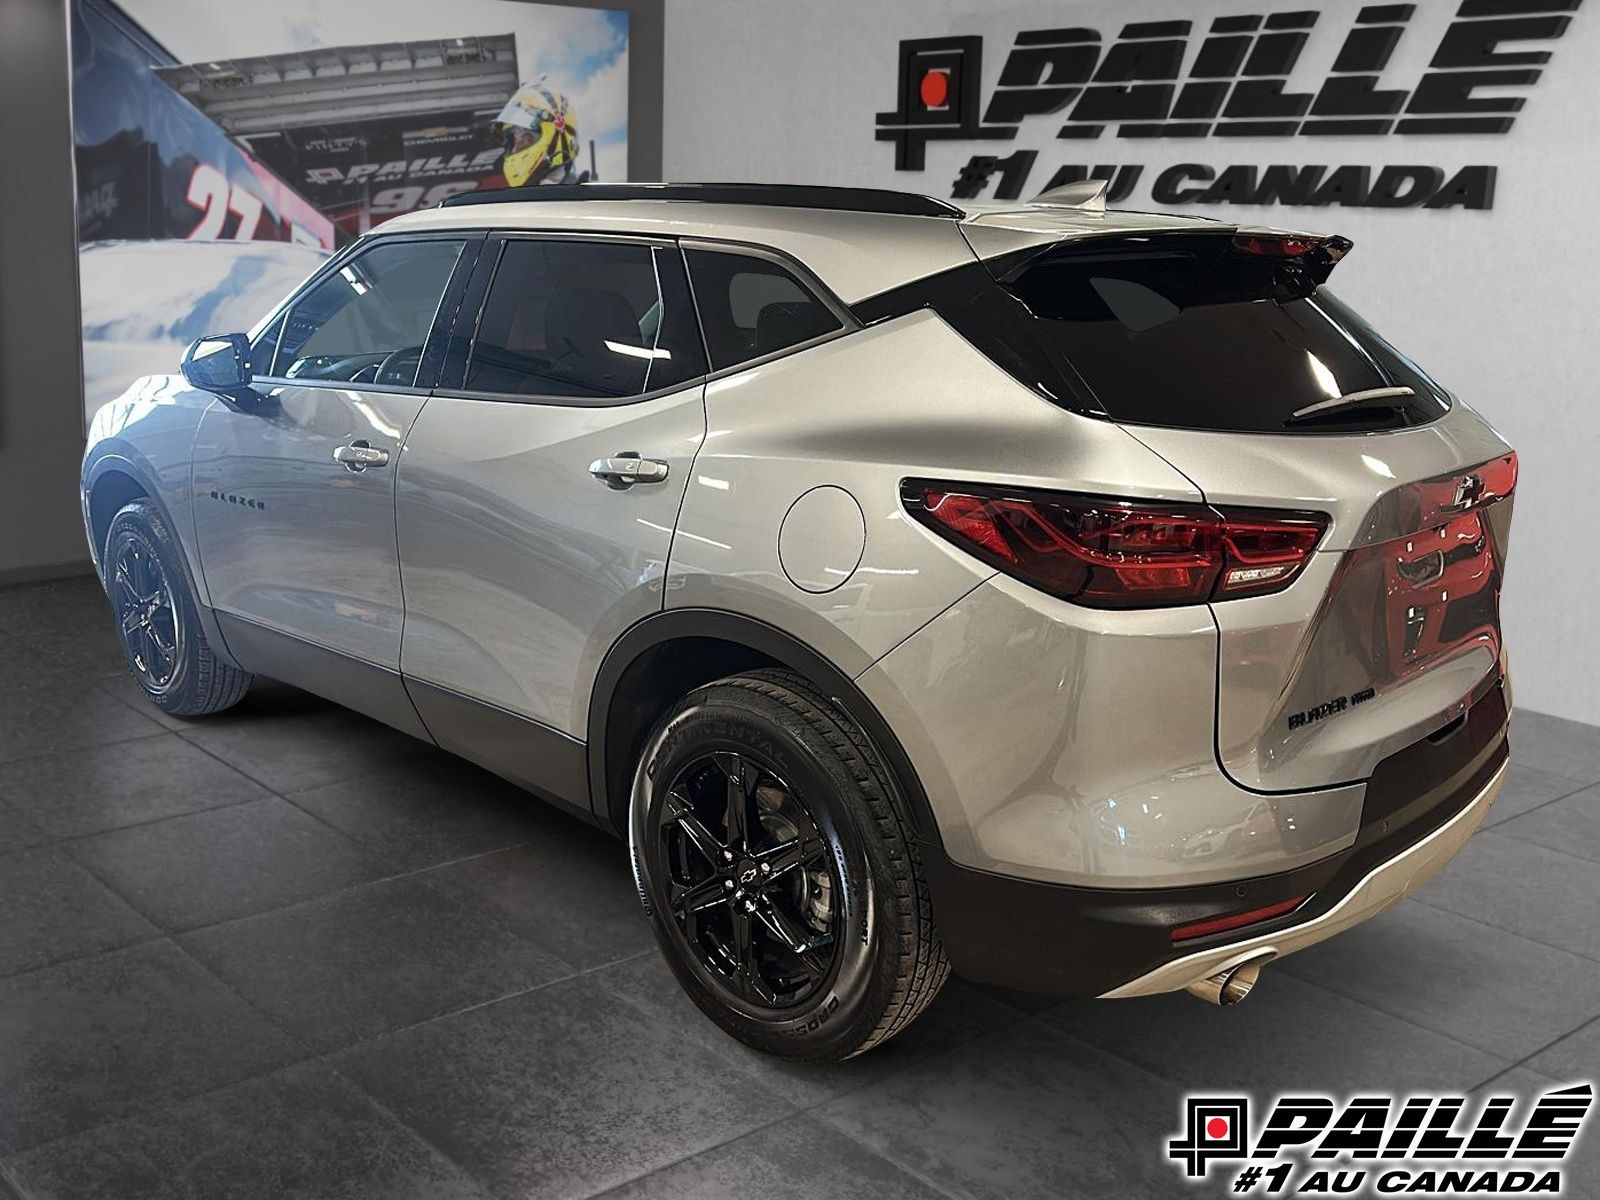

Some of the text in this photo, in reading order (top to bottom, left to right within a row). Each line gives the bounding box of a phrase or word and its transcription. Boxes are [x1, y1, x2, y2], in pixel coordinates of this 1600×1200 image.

[187, 164, 263, 241] 27
[950, 150, 1039, 200] #1
[1151, 163, 1497, 210] CANADA
[211, 491, 265, 510] BLAZER
